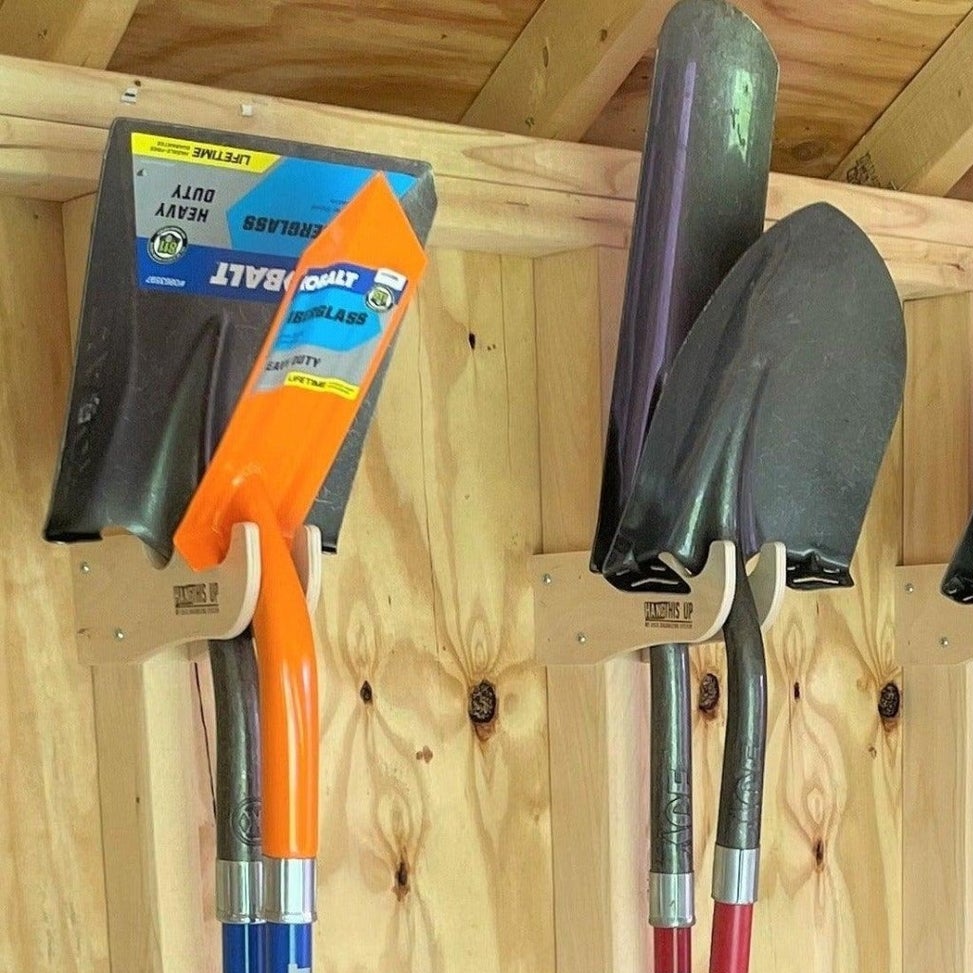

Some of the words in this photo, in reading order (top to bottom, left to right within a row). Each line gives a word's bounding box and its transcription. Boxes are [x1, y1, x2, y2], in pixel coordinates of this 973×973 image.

[192, 147, 251, 166] LIFETIME
[171, 184, 216, 203] DUTY
[154, 203, 209, 223] HEAVY
[242, 215, 326, 241] ERGLASS
